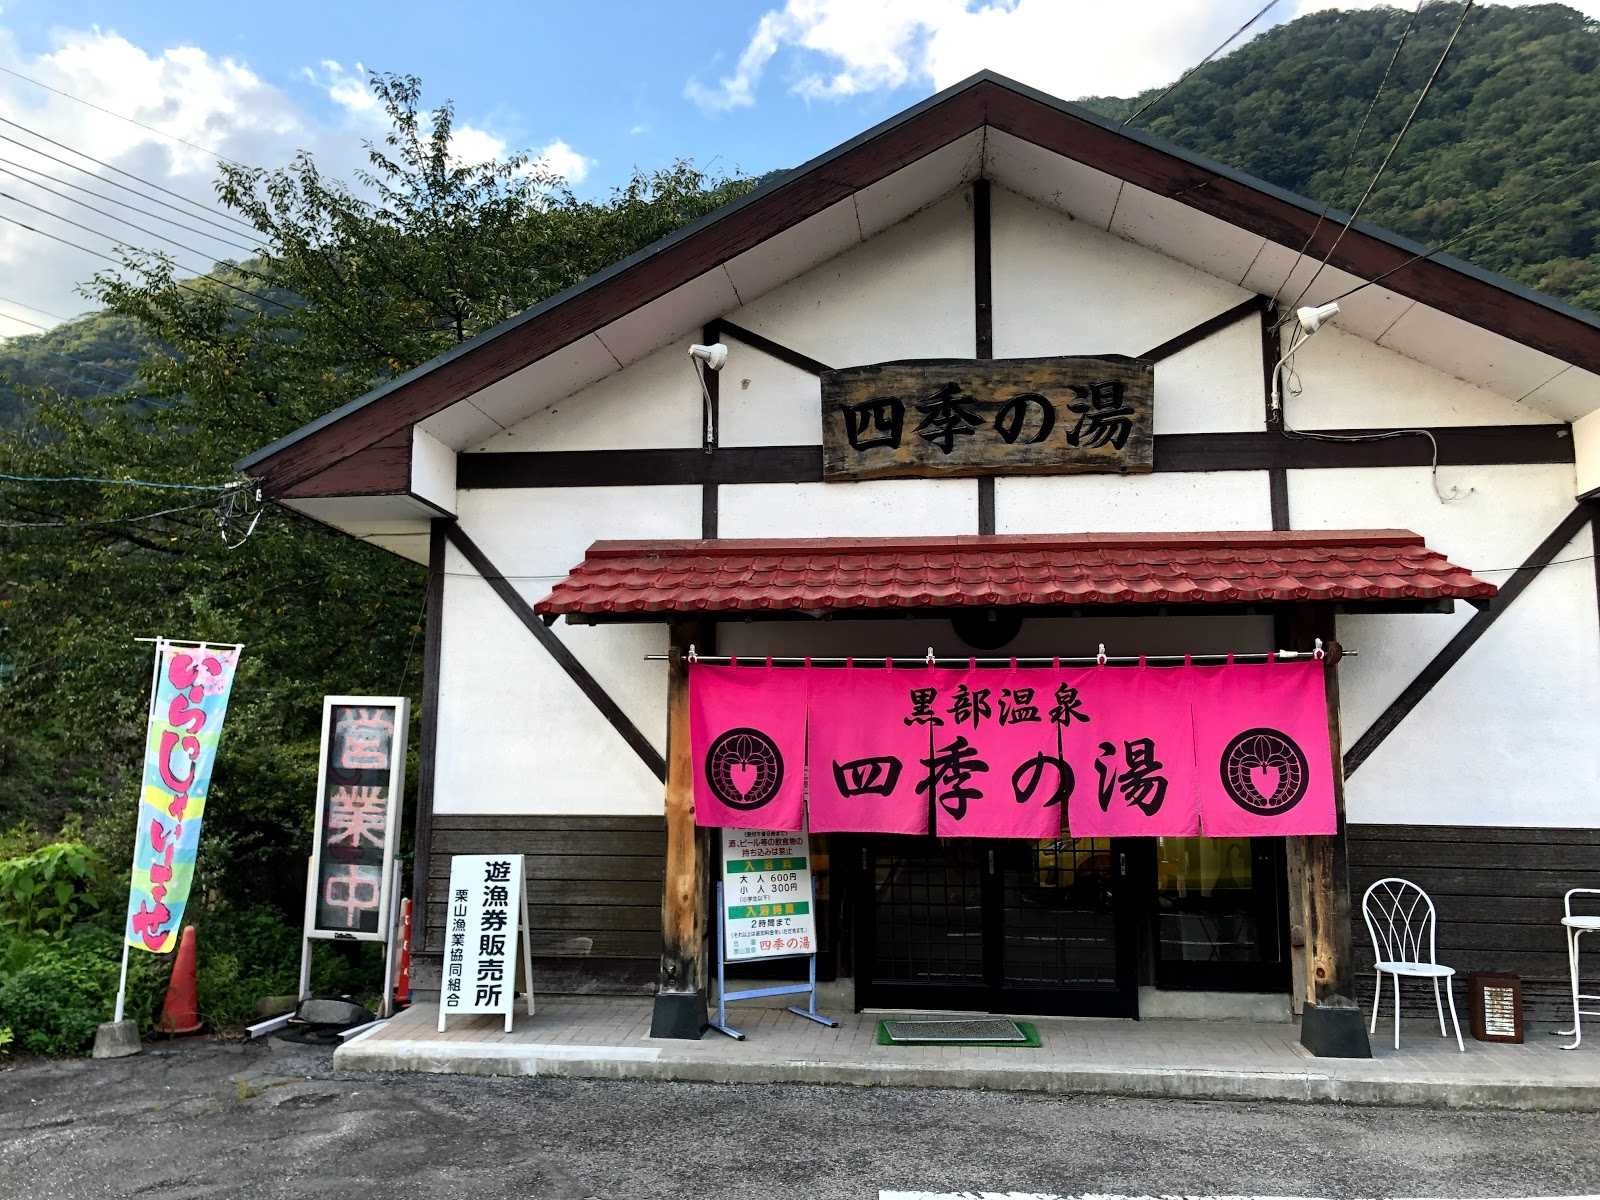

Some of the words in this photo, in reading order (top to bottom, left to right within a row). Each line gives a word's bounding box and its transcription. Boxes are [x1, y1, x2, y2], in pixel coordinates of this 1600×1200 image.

[841, 381, 1135, 455] 四季の湯
[904, 682, 1091, 731] 黒部温泉
[832, 735, 1168, 821] 四季の湯
[326, 707, 395, 928] 営業中
[770, 872, 797, 882] 600円
[771, 883, 798, 892] 300円
[447, 889, 469, 1007] 栗山漁業協同組合
[475, 861, 511, 1007] 遊漁券販売所
[751, 918, 791, 928] 2時間まで
[760, 936, 810, 951] 四季の湯
